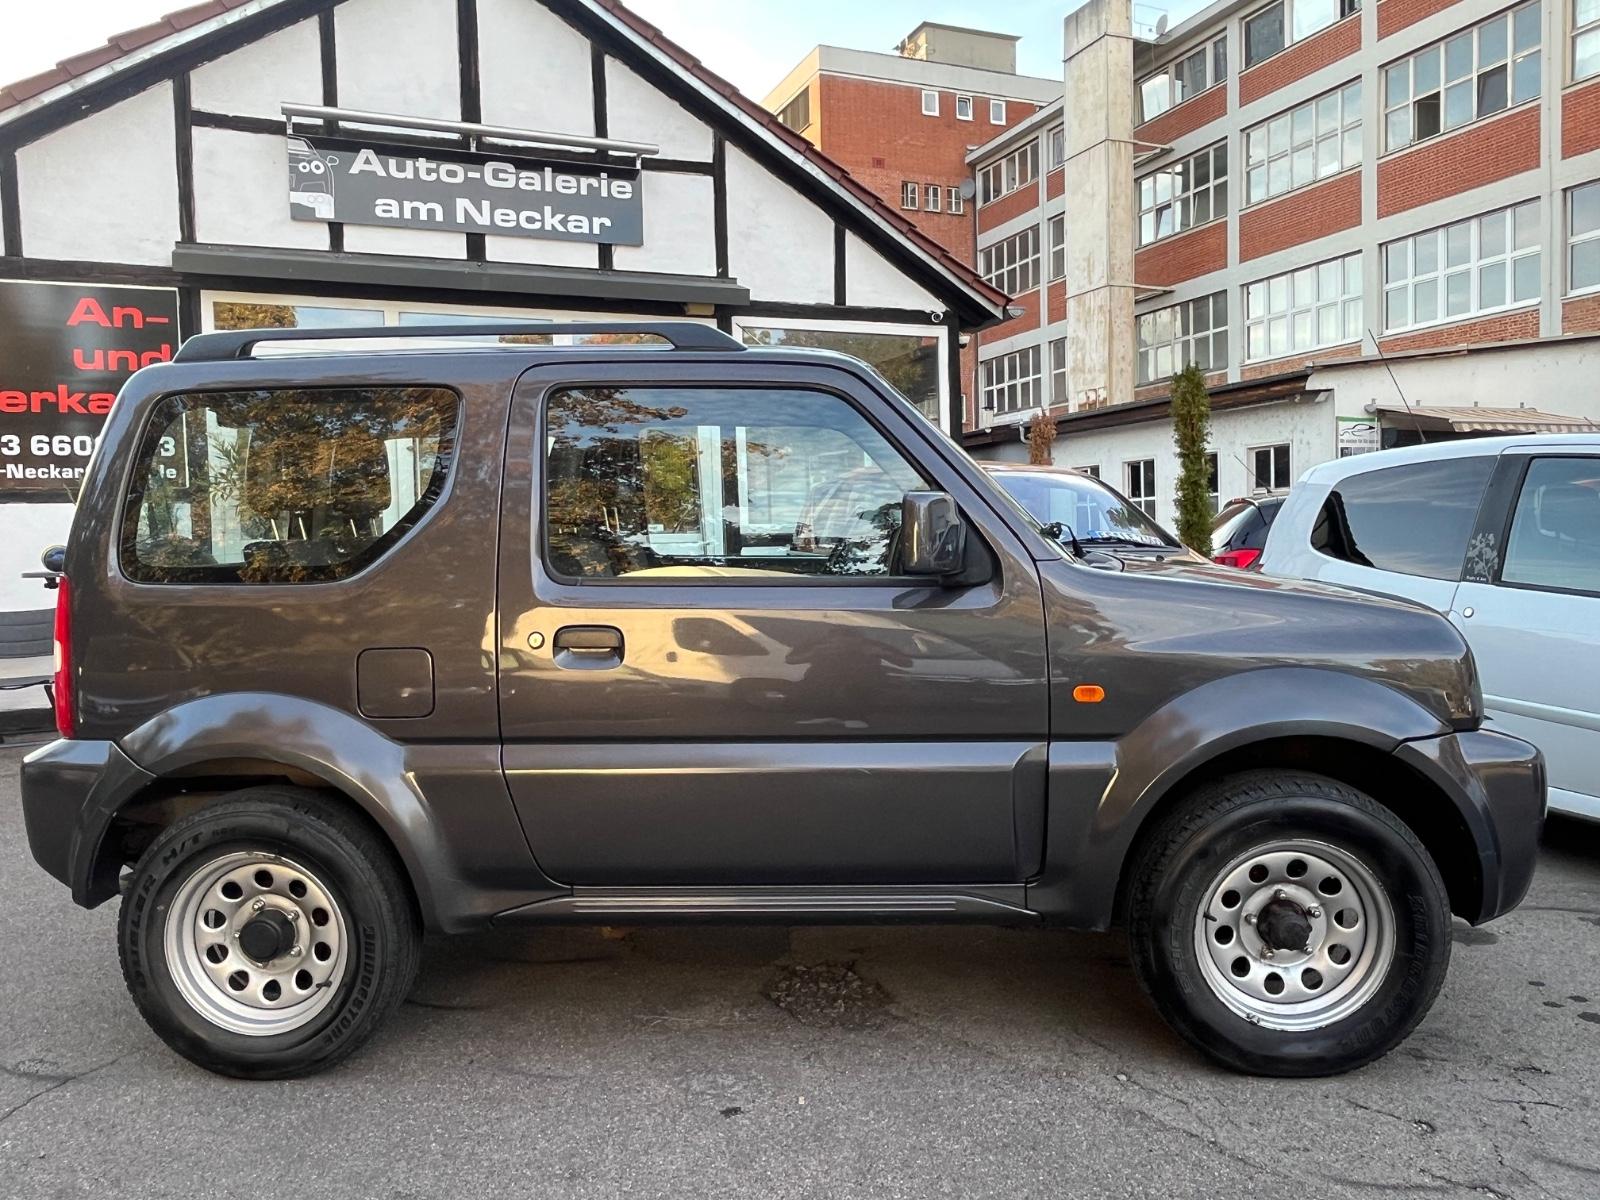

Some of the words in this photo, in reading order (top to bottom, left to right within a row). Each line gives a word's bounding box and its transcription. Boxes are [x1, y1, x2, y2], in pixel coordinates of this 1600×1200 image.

[349, 149, 633, 199] Auto-Galerie
[374, 198, 443, 222] am
[456, 198, 611, 235] Neckar
[66, 297, 169, 328] An-
[73, 344, 171, 371] und
[0, 434, 20, 456] 3
[30, 434, 100, 456] 660
